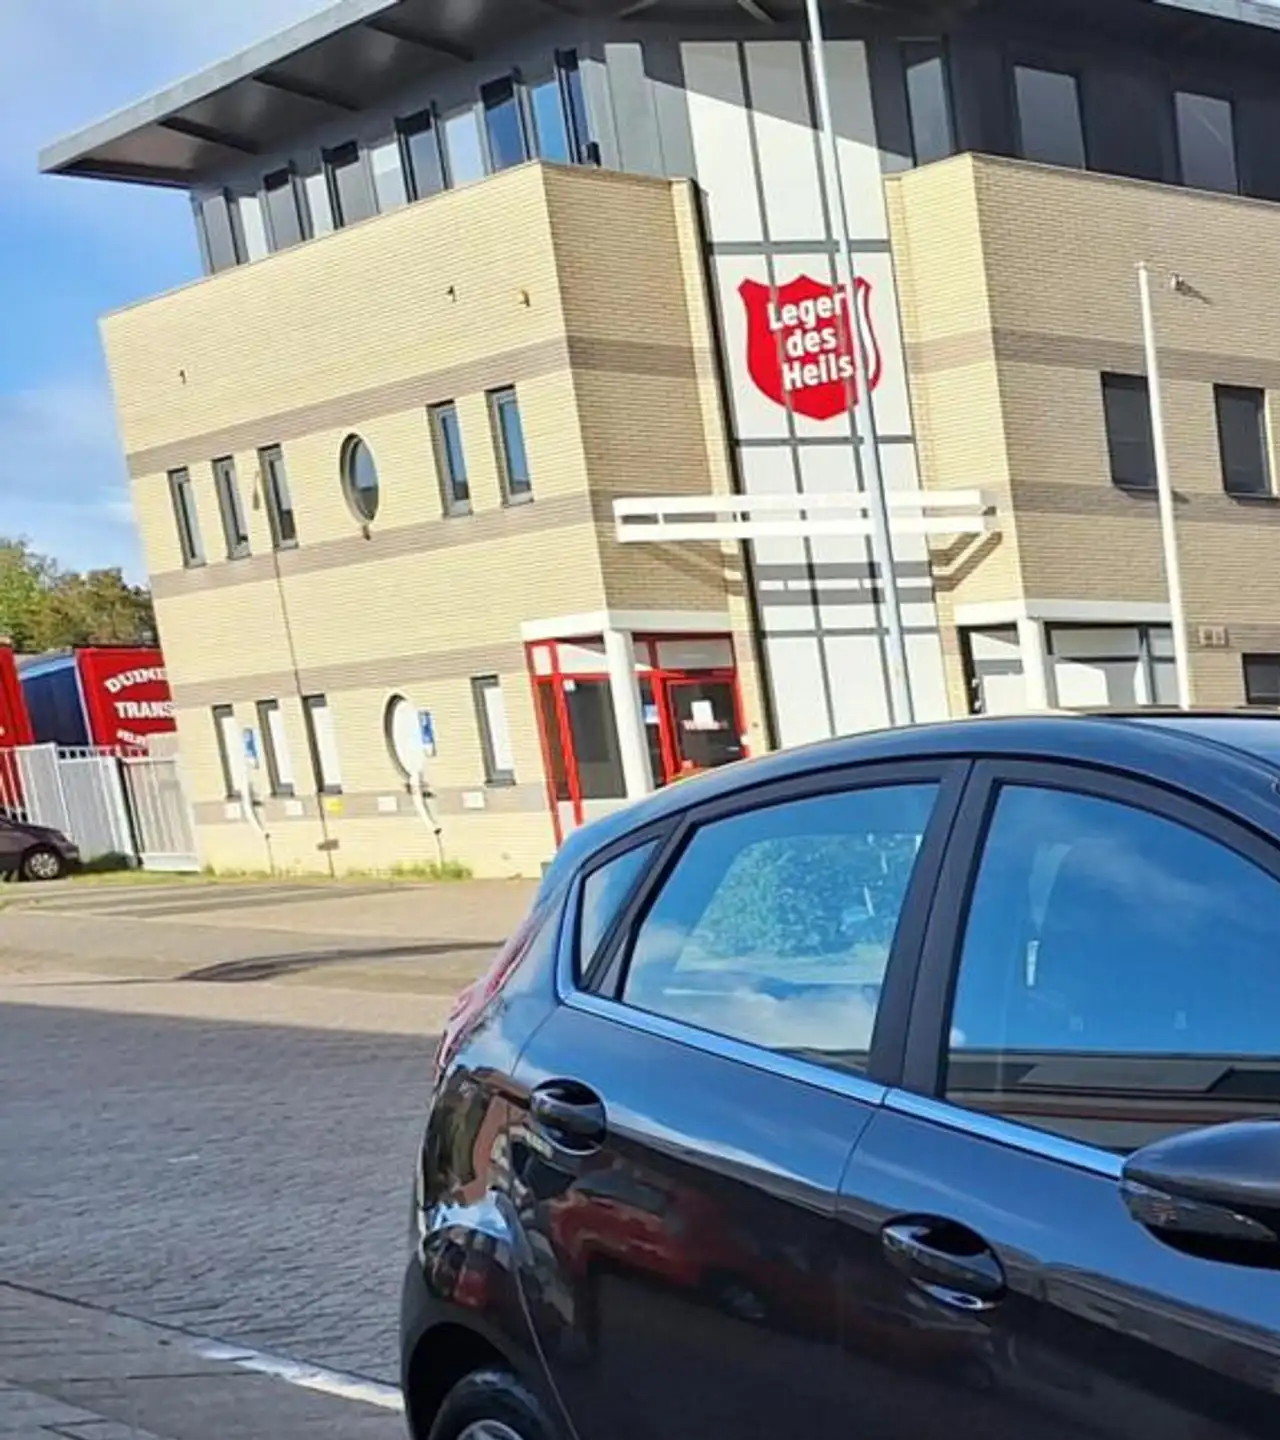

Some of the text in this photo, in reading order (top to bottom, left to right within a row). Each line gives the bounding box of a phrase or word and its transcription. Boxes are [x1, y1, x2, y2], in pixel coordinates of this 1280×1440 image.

[766, 291, 847, 331] Leger
[785, 326, 838, 358] des
[781, 353, 854, 392] Heils
